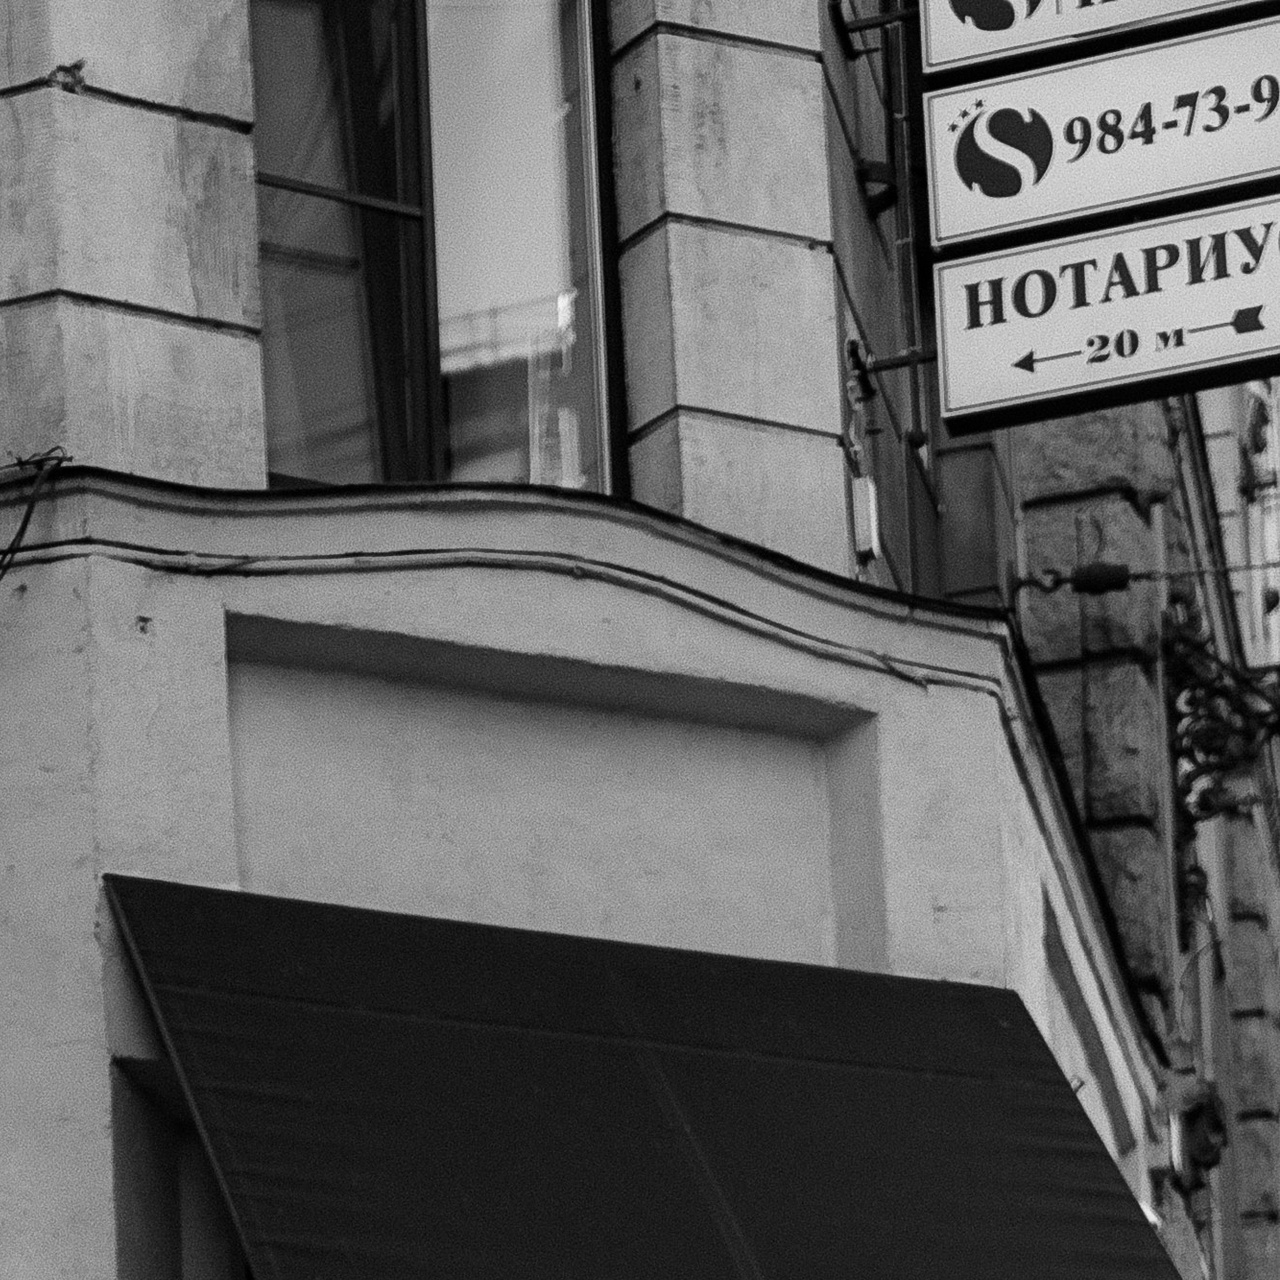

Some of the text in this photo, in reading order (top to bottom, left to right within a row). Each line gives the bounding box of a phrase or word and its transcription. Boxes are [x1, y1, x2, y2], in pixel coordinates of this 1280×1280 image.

[1062, 74, 1280, 163] 984-73-9
[963, 222, 1280, 330] НОТАРИУ
[1085, 330, 1140, 364] 20
